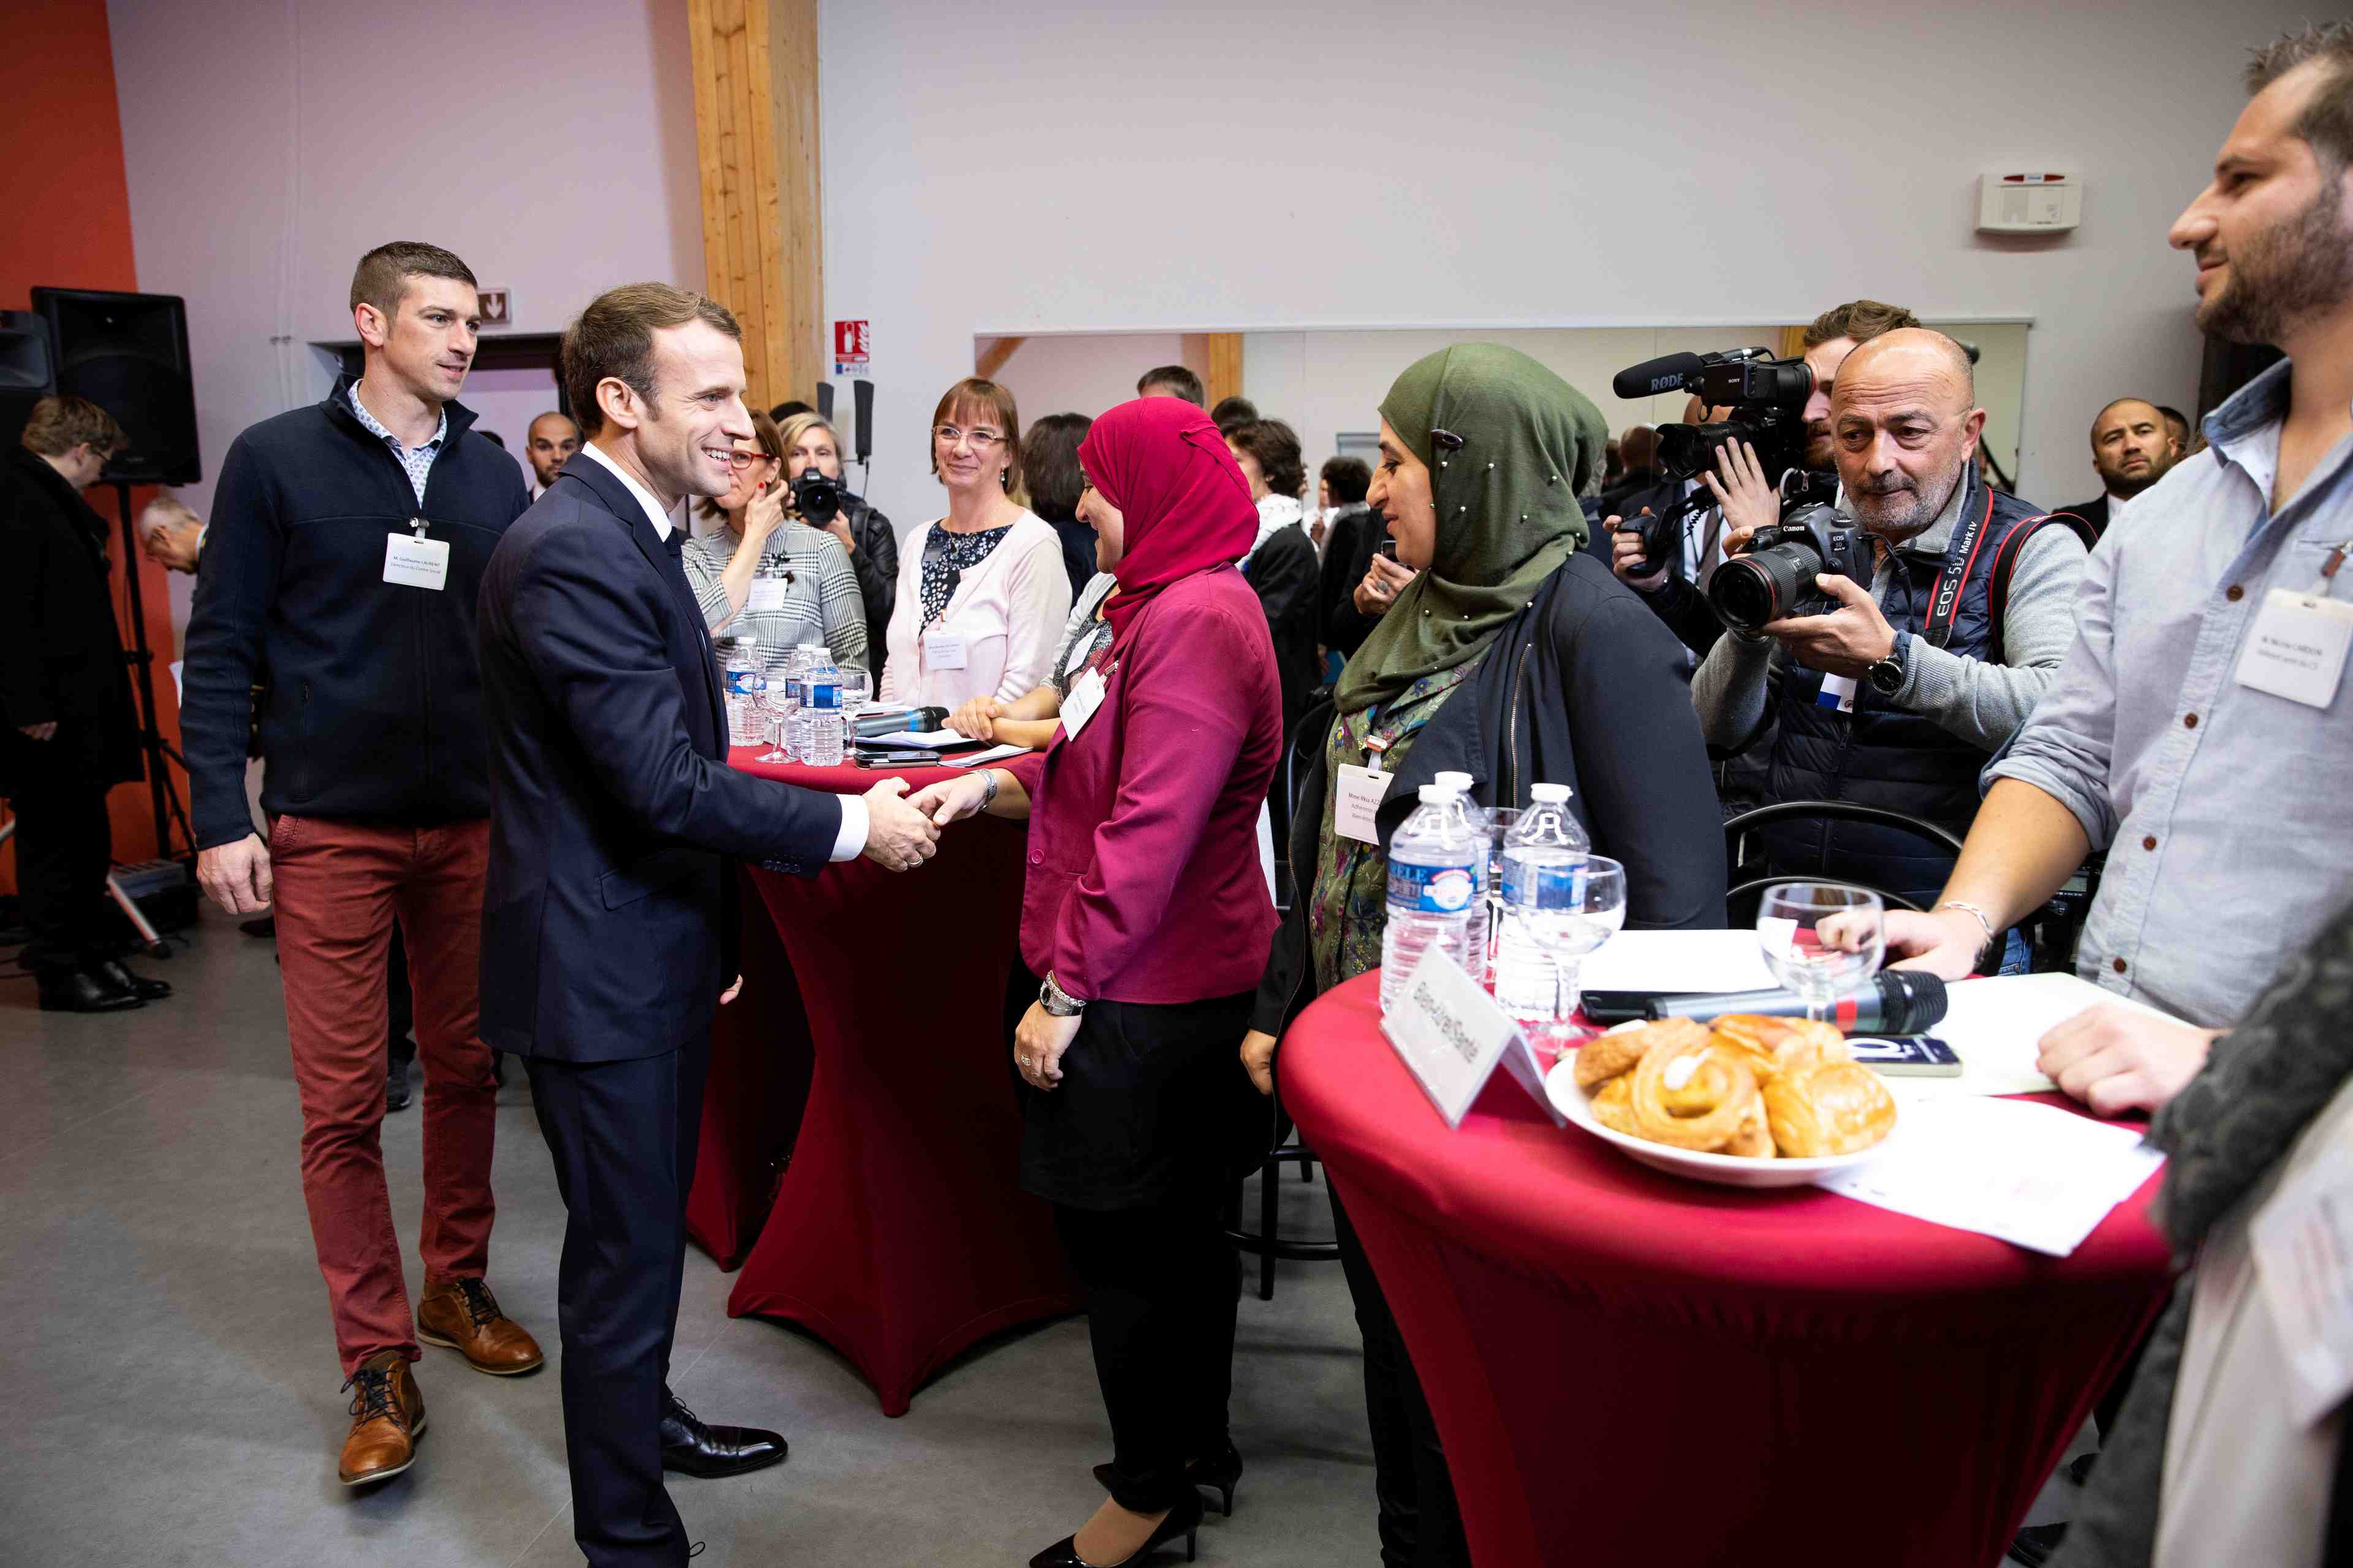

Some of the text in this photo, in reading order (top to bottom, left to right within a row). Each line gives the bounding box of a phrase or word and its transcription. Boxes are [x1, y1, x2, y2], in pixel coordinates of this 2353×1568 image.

[1651, 373, 1683, 392] RØDE
[1936, 579, 1958, 617] EOS
[1958, 531, 1976, 554] Mark
